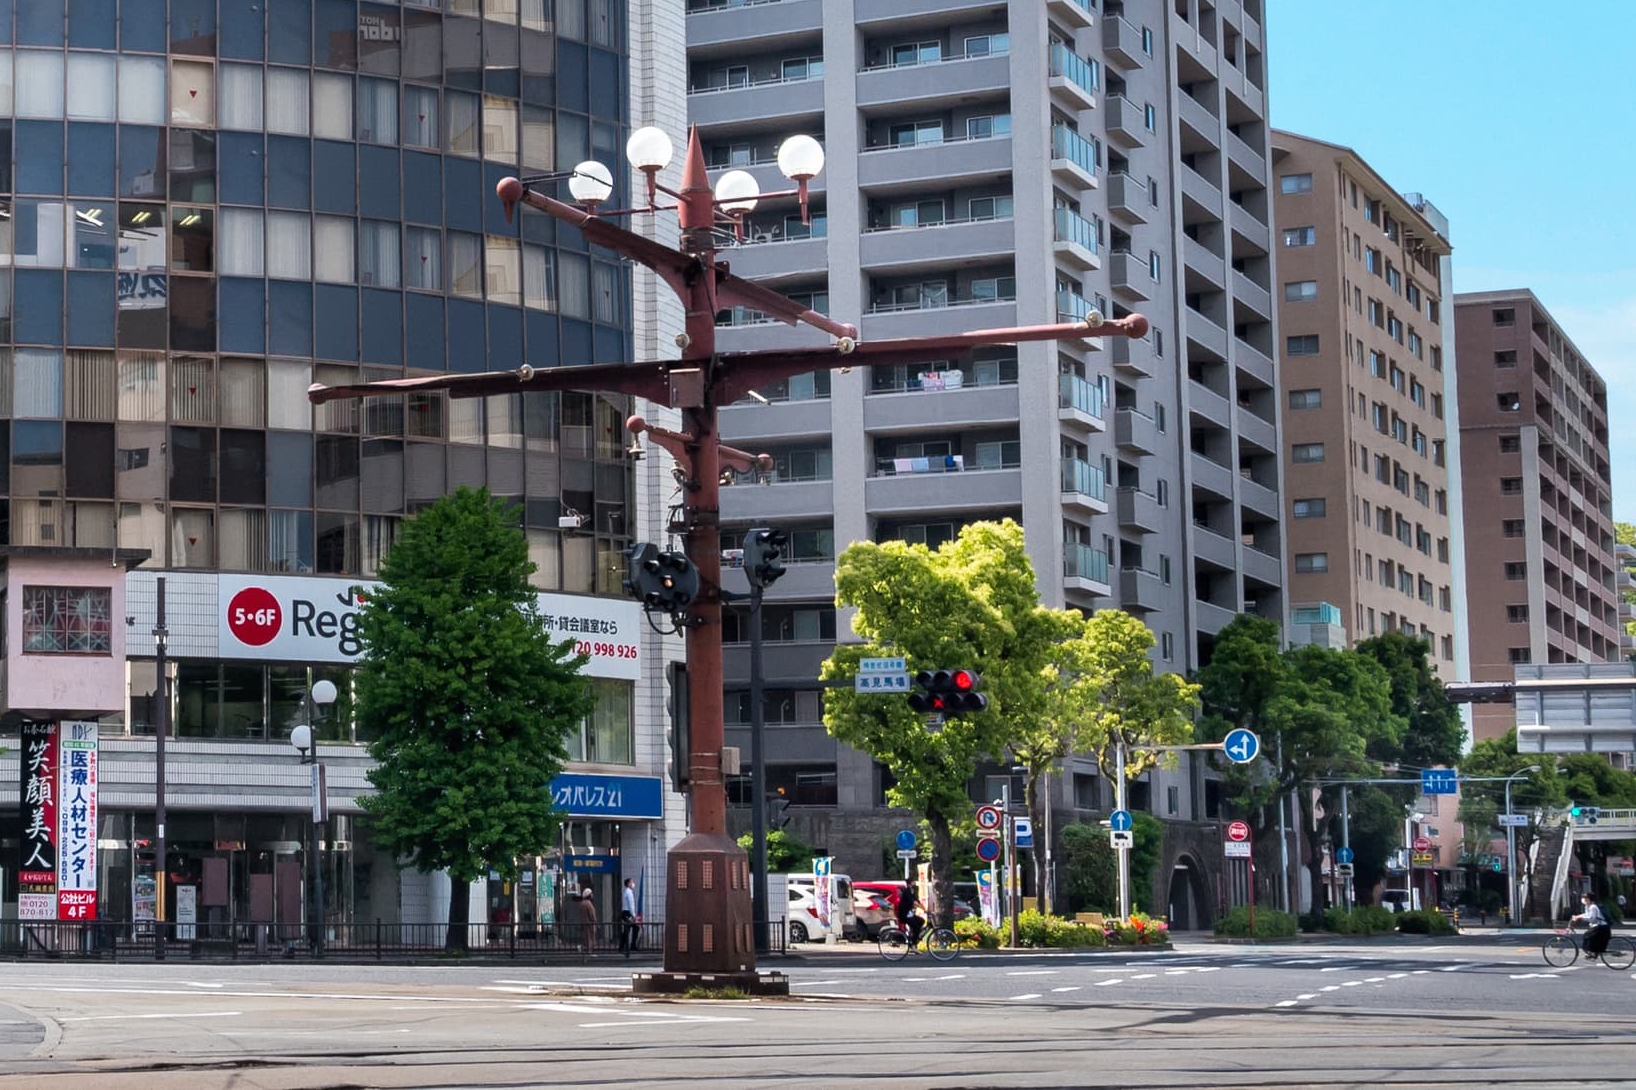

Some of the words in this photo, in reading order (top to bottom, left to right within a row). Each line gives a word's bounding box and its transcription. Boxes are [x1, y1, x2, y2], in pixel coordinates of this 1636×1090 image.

[522, 612, 619, 635] 所・貸会議室なら
[594, 642, 615, 657] 998
[618, 644, 637, 659] 926
[860, 676, 905, 688] 高見馬場
[24, 739, 54, 868] 笑顔美人
[70, 750, 88, 888] 医療人材センター
[29, 900, 49, 908] 0120
[60, 893, 95, 905] 公社ビル
